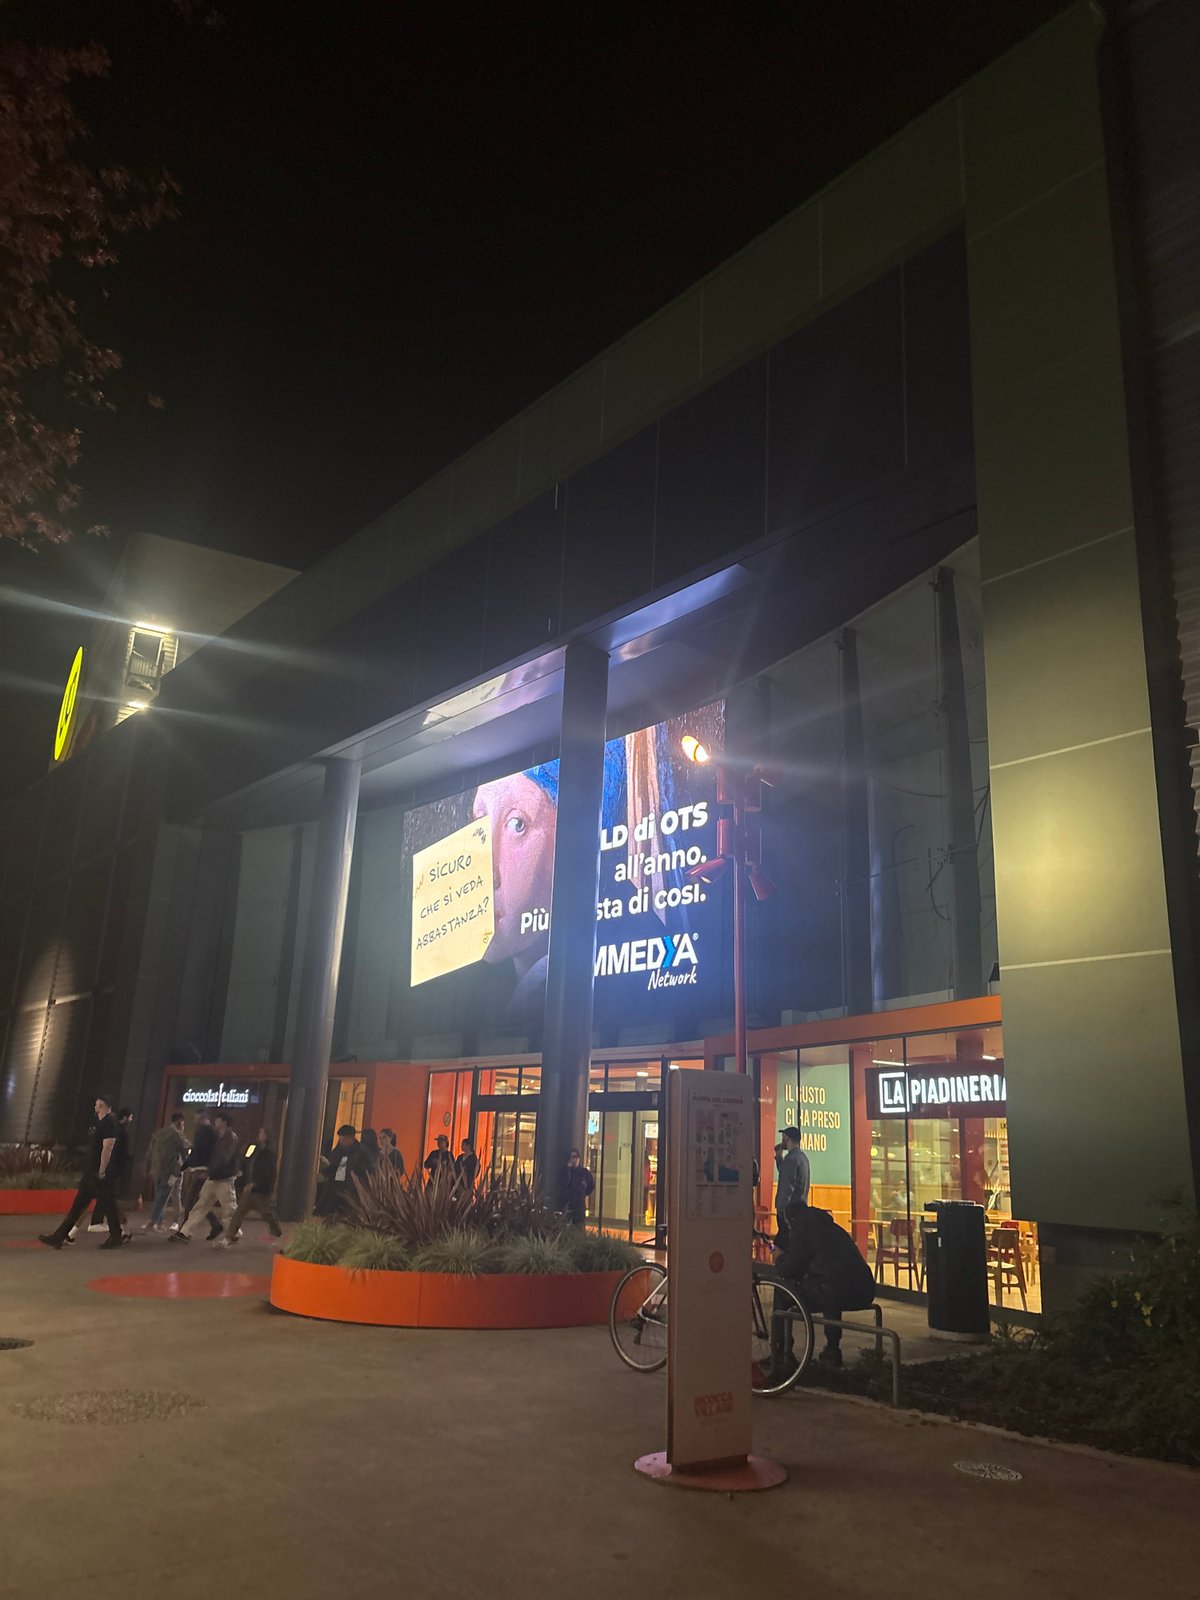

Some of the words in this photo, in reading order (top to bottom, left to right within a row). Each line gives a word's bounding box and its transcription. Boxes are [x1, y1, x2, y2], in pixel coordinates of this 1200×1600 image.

[634, 813, 656, 842] di
[660, 802, 709, 835] OTS
[420, 899, 441, 919] CHE
[455, 875, 484, 899] VEDA
[520, 907, 550, 934] Più
[628, 886, 649, 915] di
[415, 895, 490, 951] ABBASTANZA?
[647, 965, 697, 991] Network
[785, 1083, 794, 1102] IL
[883, 1079, 905, 1105] LA
[785, 1107, 795, 1126] CI
[811, 1110, 841, 1130] PRESO
[799, 1133, 827, 1152] MANO
